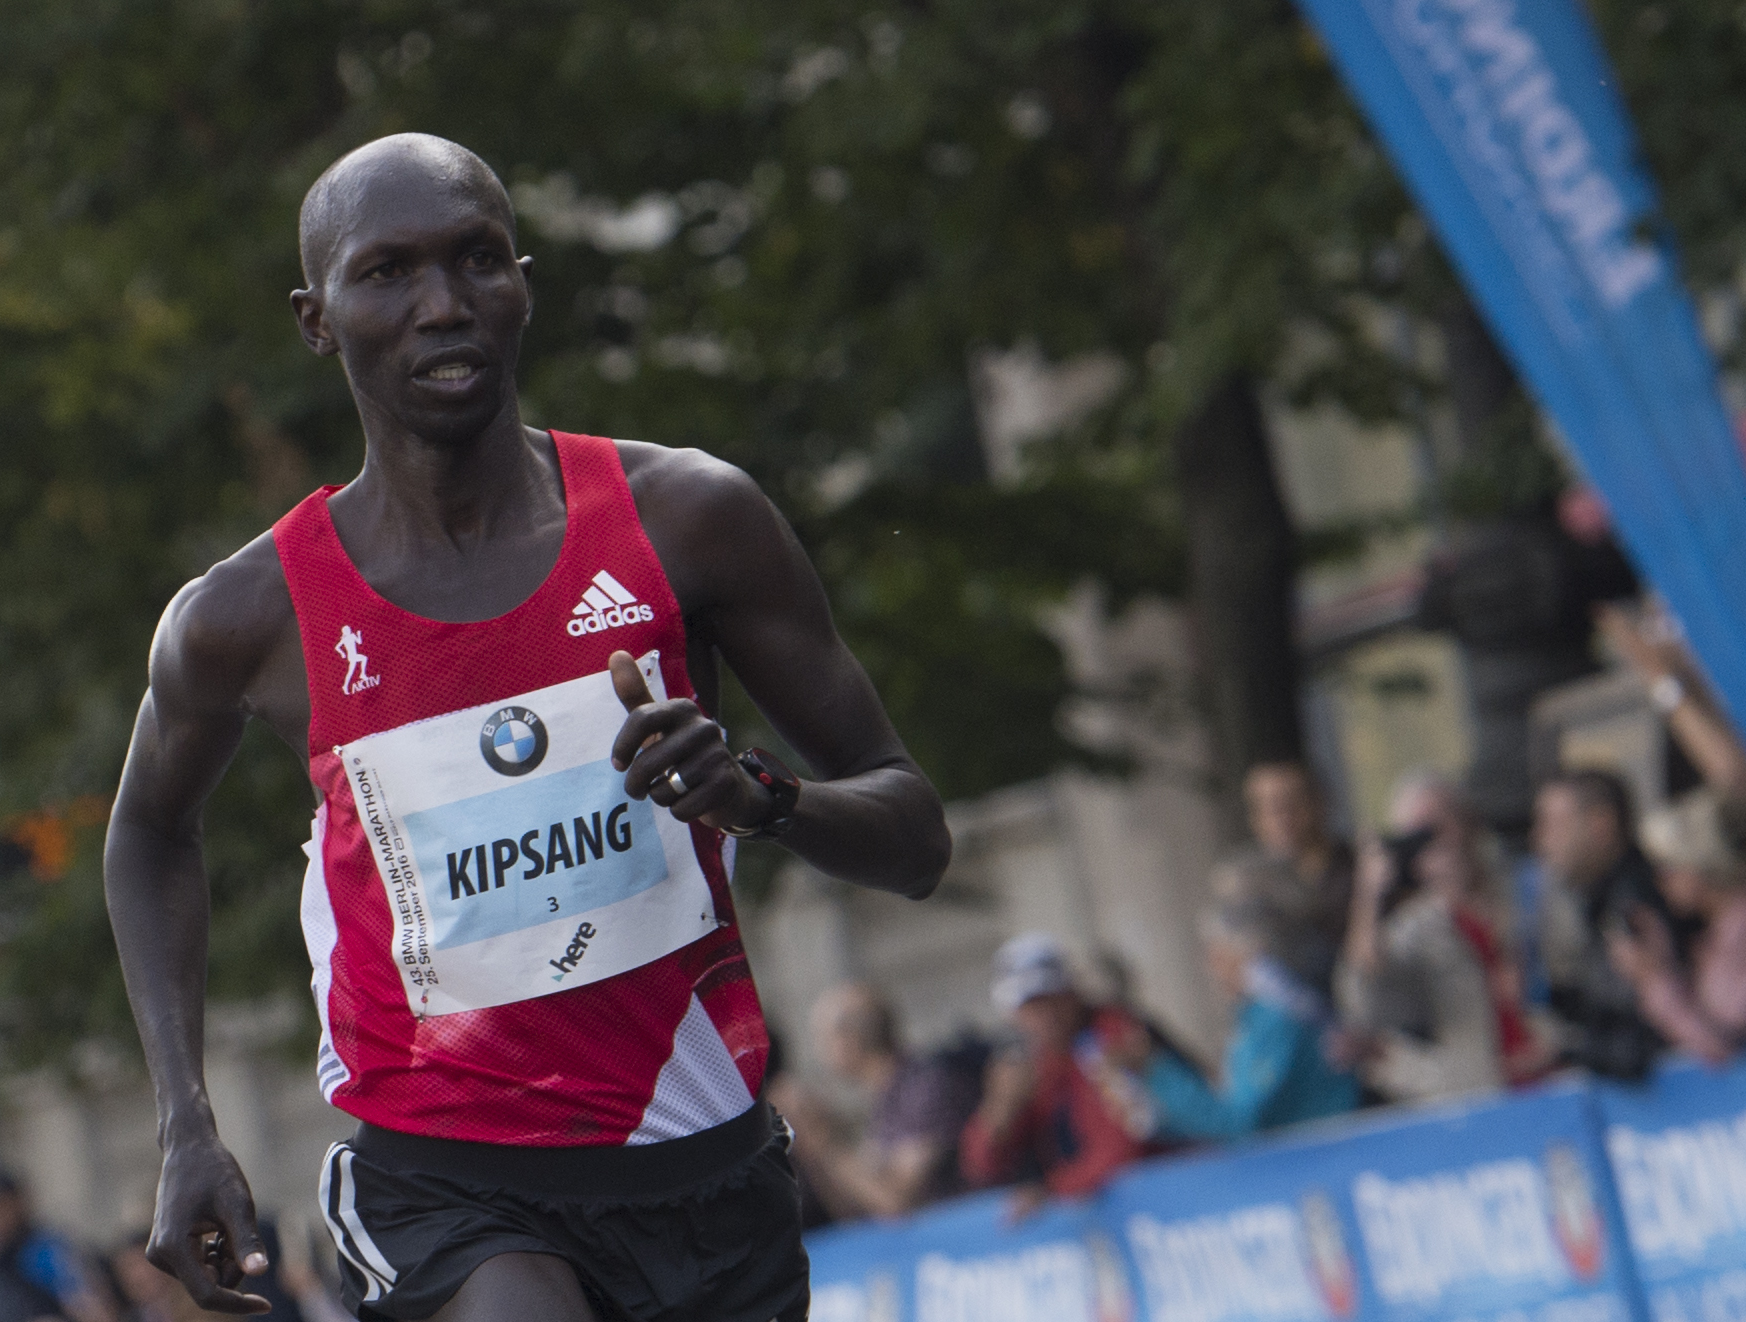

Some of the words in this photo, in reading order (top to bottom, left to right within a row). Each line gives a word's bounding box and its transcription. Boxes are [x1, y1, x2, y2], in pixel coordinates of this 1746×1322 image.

[566, 604, 654, 637] adidas
[355, 770, 414, 926] BERLIN-MARATHON
[446, 801, 633, 901] KIPSANG
[397, 854, 417, 889] 2016
[547, 896, 559, 912] 3
[410, 891, 432, 965] September
[401, 928, 417, 966] BMW
[549, 921, 597, 974] here
[409, 966, 425, 987] 43.
[423, 966, 439, 985] 25.
